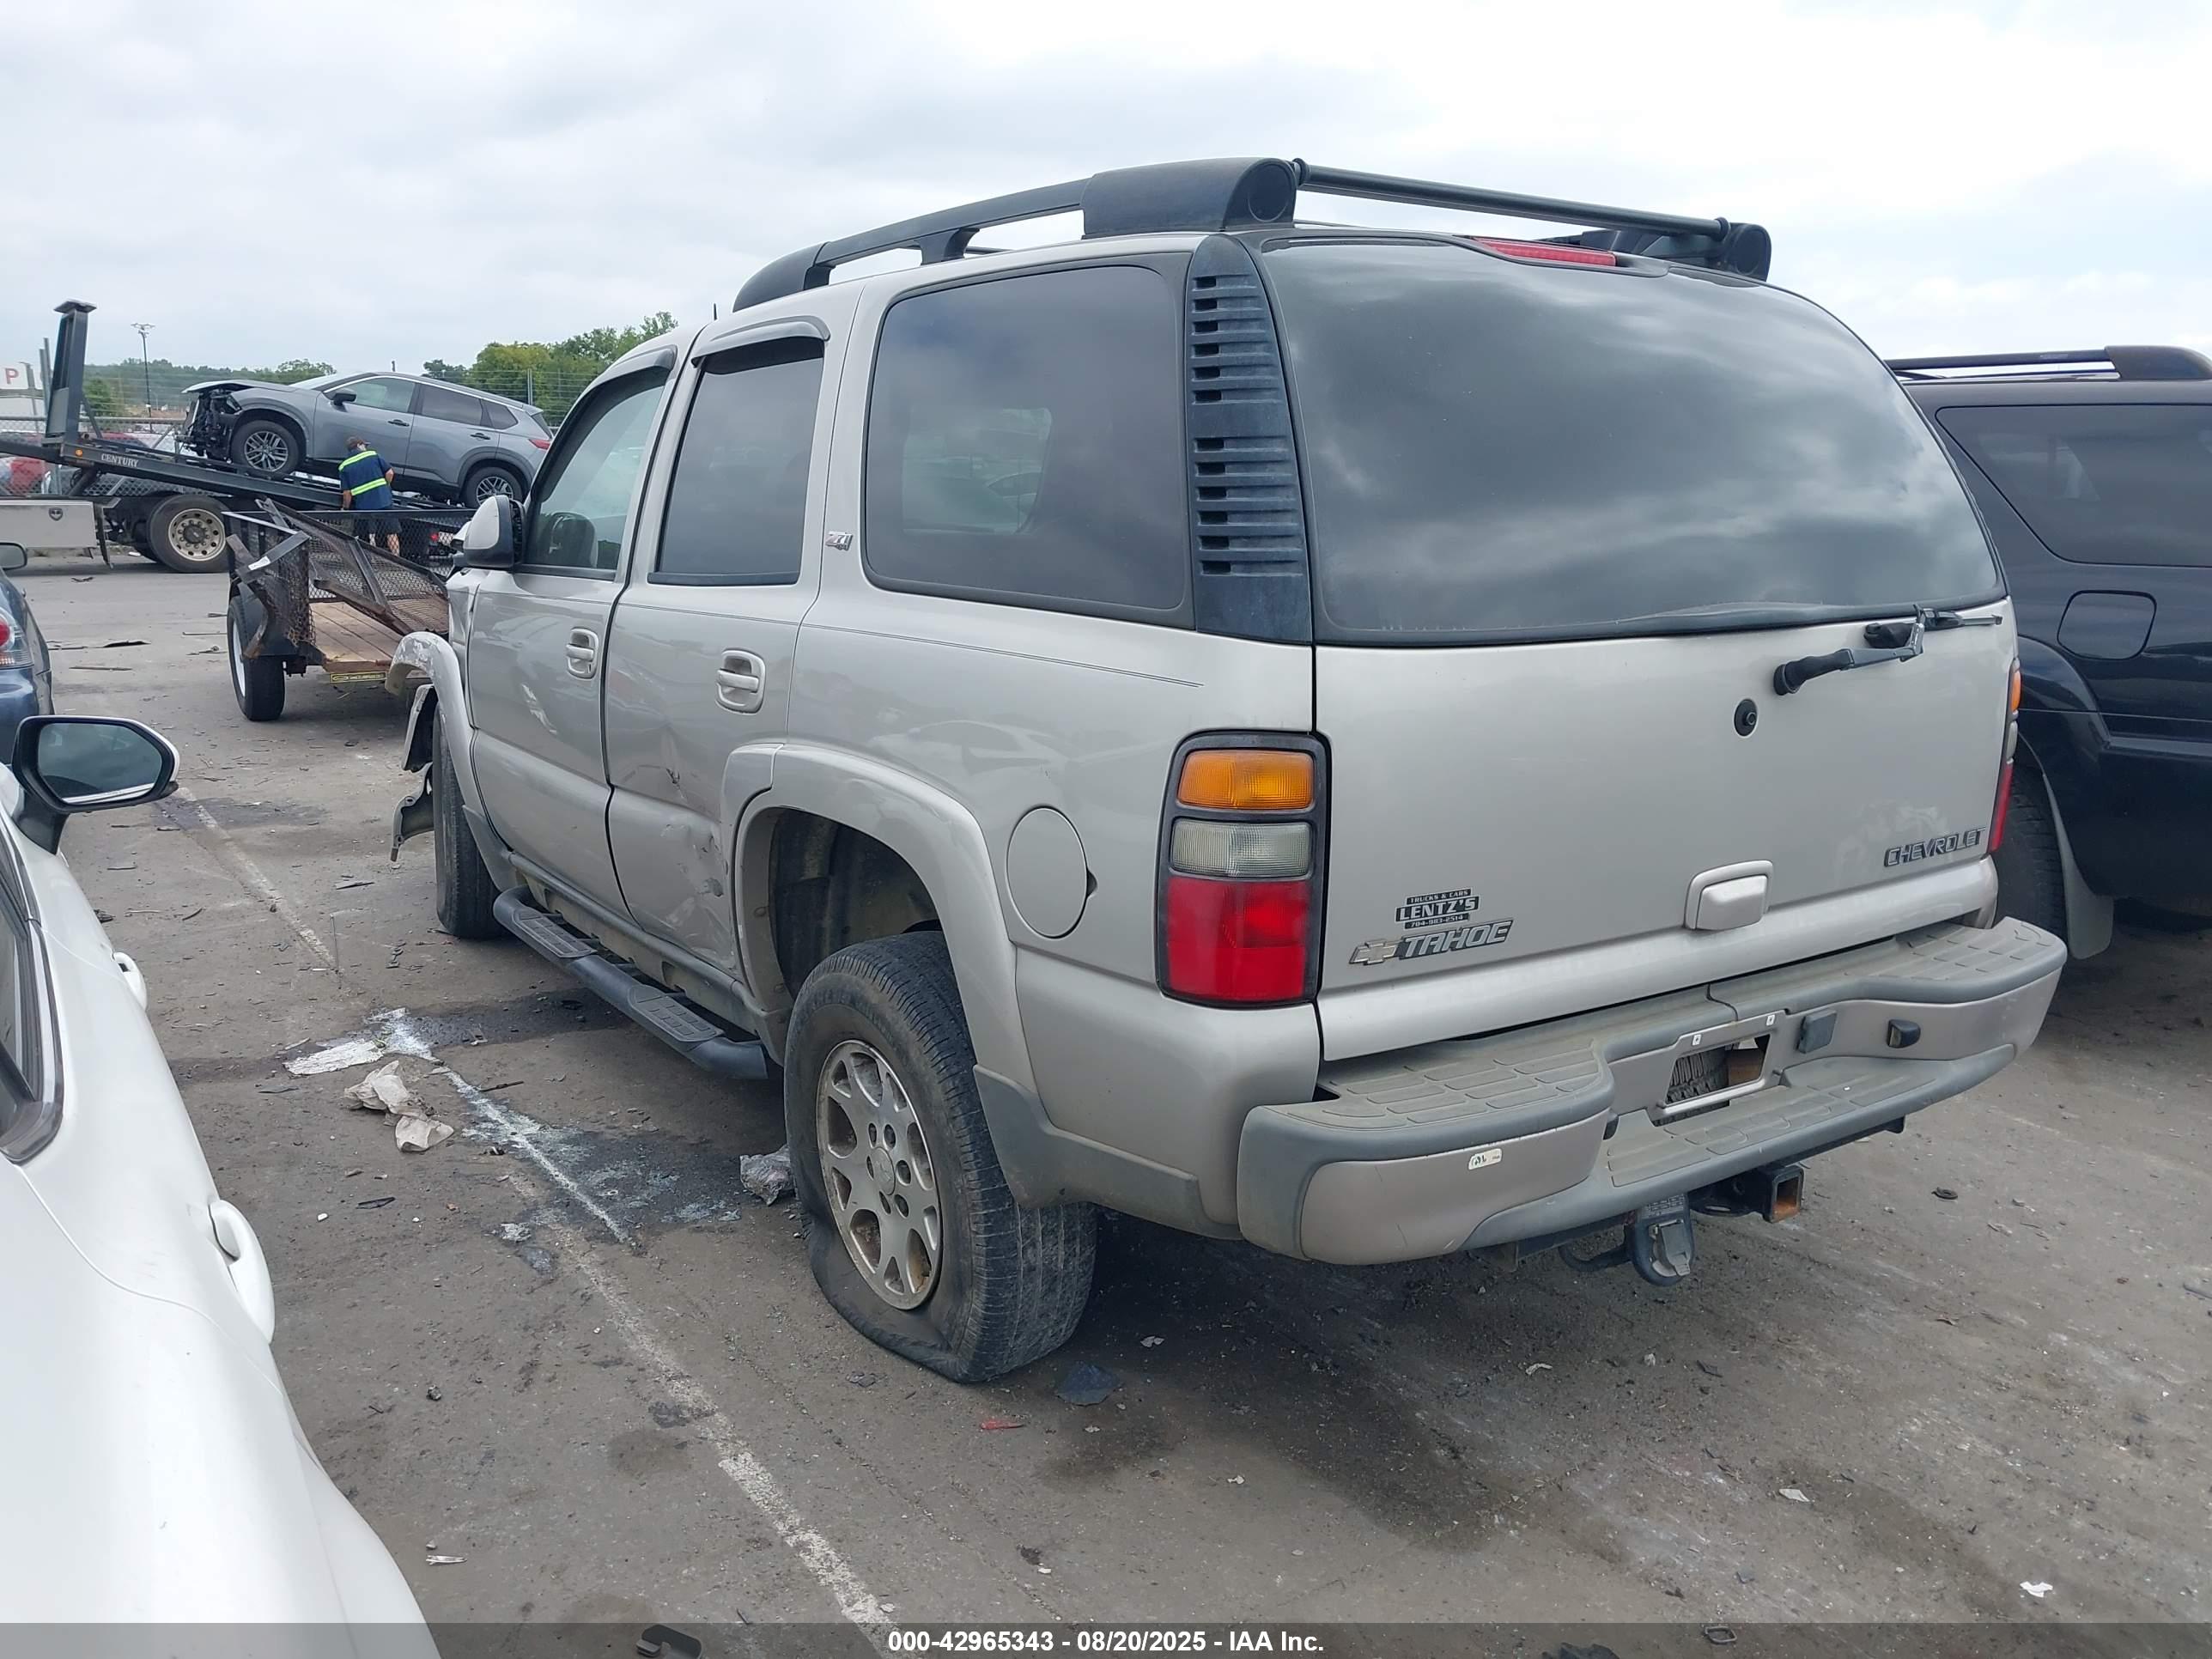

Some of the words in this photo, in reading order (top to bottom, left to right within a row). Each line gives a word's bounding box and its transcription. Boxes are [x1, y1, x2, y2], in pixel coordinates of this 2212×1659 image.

[5, 368, 19, 385] P
[100, 453, 139, 468] CENTURY
[825, 532, 852, 550] Z71
[1884, 827, 1986, 867] CHEVROLET
[1410, 895, 1439, 903] TRUCKS
[1449, 890, 1468, 898] CARS
[1399, 897, 1476, 921] LENTZ'S
[1404, 921, 1512, 957] TAHOE
